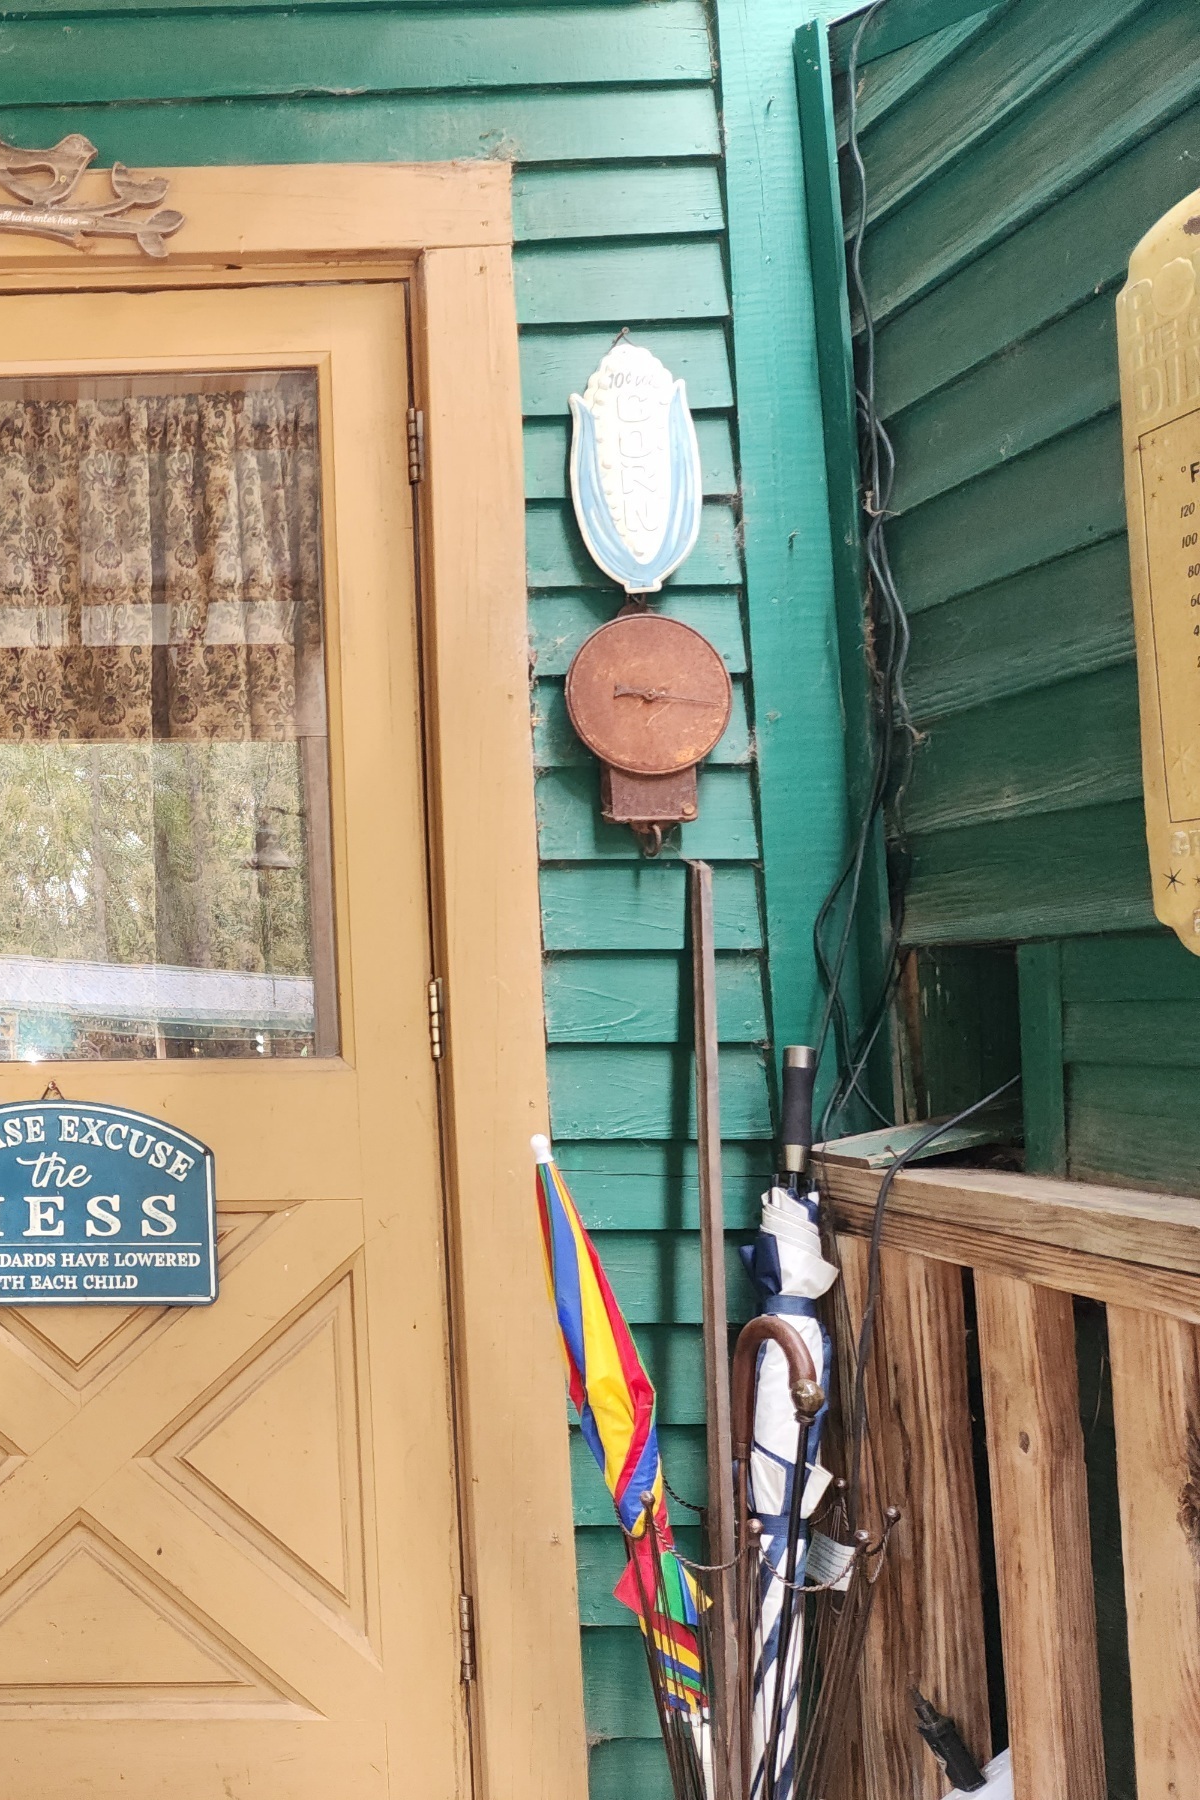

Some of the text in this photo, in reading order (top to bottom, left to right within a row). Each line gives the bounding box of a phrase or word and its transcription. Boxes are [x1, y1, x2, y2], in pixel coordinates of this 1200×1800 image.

[11, 211, 32, 222] who
[33, 215, 56, 224] enter
[57, 214, 79, 226] here
[1180, 502, 1195, 518] 120
[1182, 532, 1198, 548] 100
[57, 1114, 196, 1183] EXCUSE
[15, 1151, 93, 1189] the
[61, 1252, 110, 1268] HAVE
[114, 1252, 201, 1268] LOWERED
[30, 1274, 79, 1291] EACH
[82, 1274, 139, 1290] CHILD
